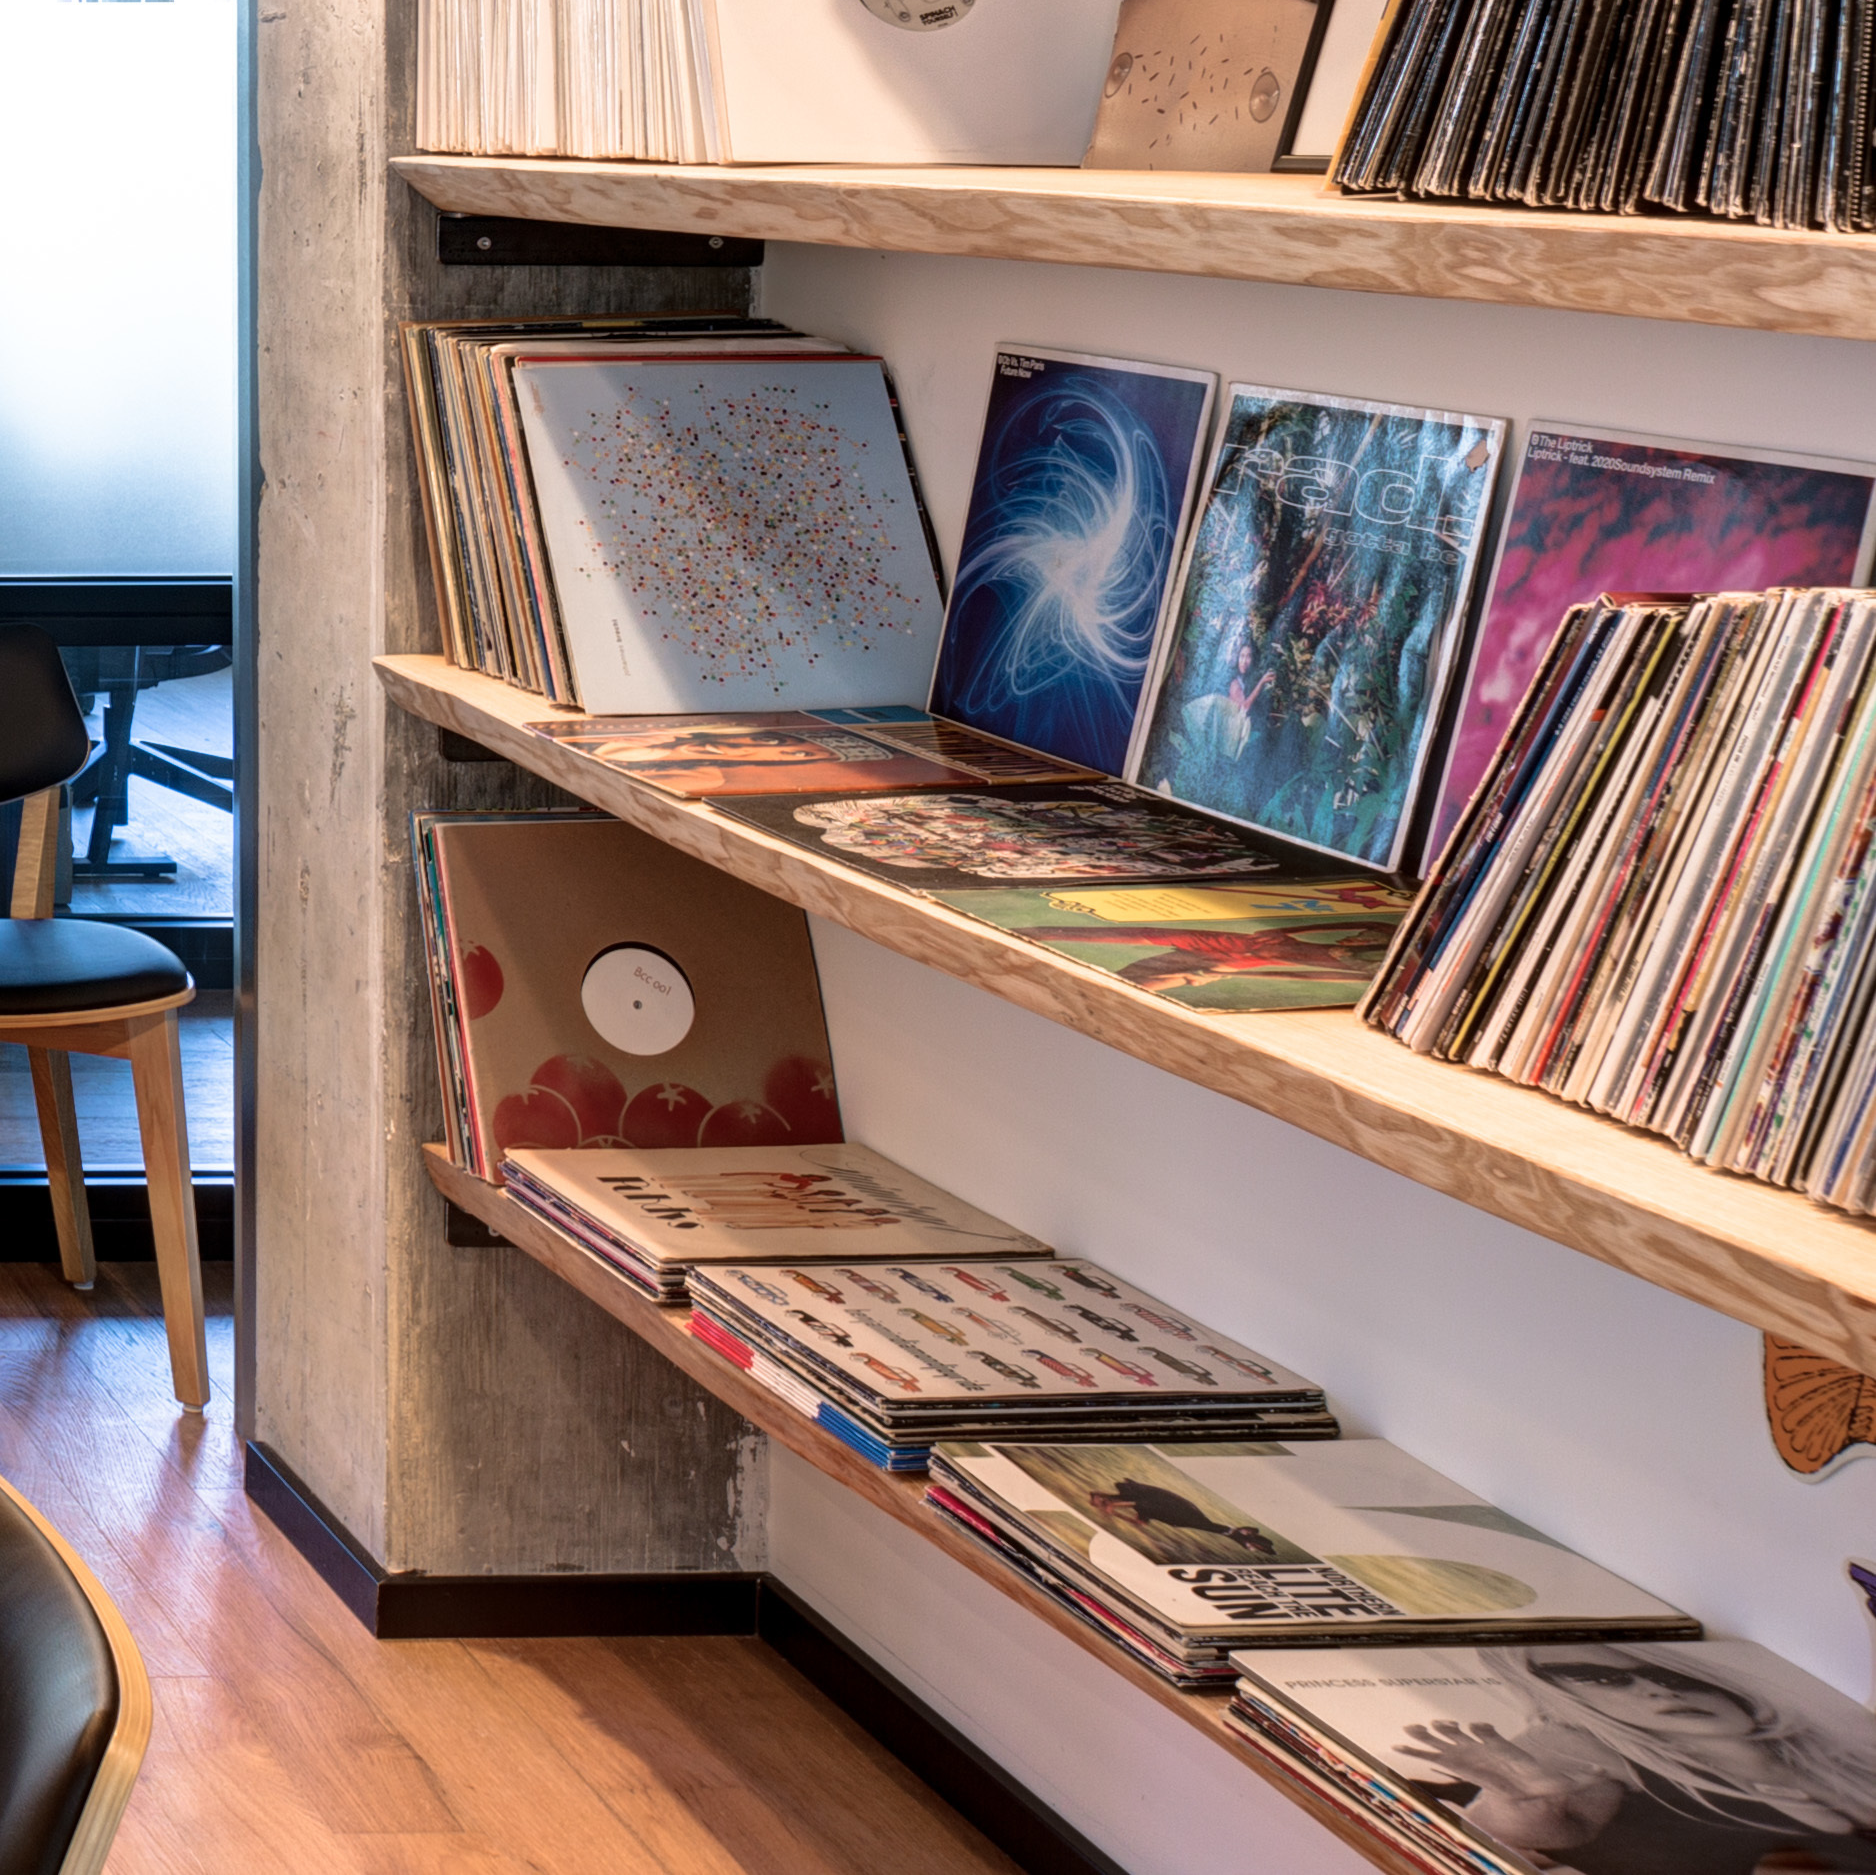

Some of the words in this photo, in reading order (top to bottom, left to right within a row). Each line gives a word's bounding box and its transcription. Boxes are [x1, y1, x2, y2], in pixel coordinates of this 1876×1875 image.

[1528, 447, 1562, 462] Liptrick
[1683, 468, 1716, 485] Remix
[1539, 435, 1556, 448] The
[1557, 437, 1593, 453] Liptrick
[1167, 1568, 1295, 1620] SUN
[1227, 1567, 1285, 1598] REACH
[1278, 1599, 1319, 1618] THE
[1249, 1568, 1380, 1617] LITE
[1310, 1566, 1406, 1616] NORTHERN
[1284, 1679, 1376, 1690] PRINCESS
[1378, 1677, 1479, 1688] SUPERSTAR
